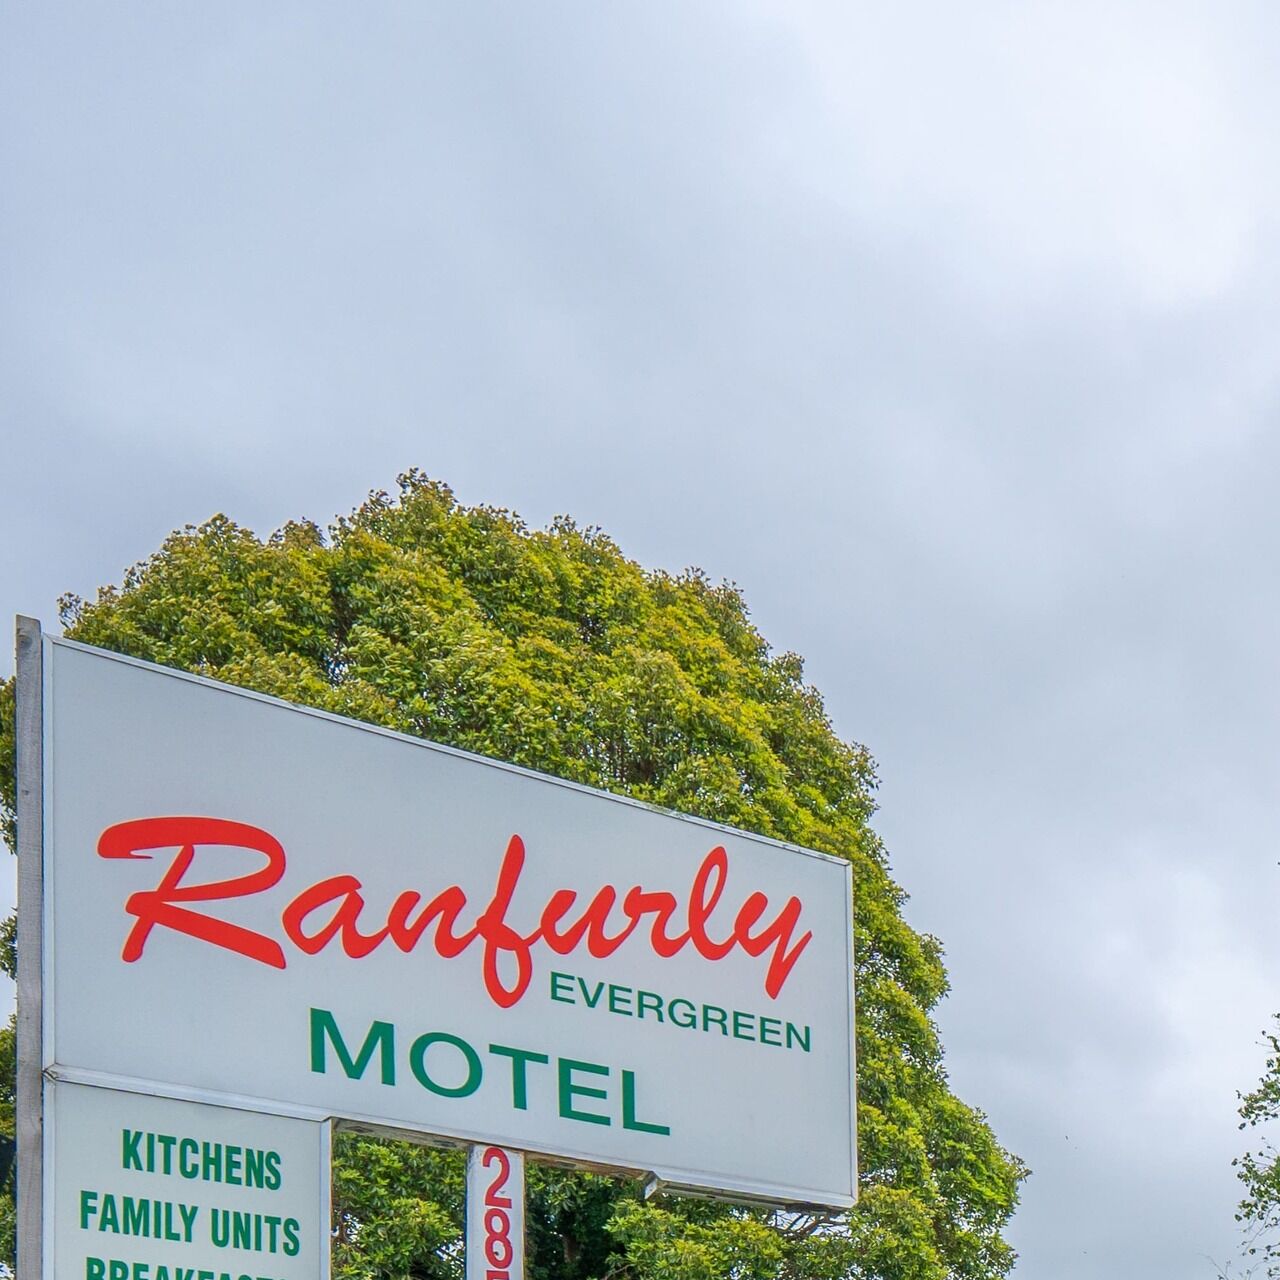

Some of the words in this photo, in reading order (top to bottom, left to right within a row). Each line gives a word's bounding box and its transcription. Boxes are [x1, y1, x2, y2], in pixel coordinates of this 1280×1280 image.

[97, 816, 812, 1009] Ranfurly
[550, 971, 811, 1053] EVERGREEN
[310, 1007, 671, 1137] MOTEL
[122, 1128, 282, 1191] KITCHENS
[80, 1190, 199, 1243] FAMILY
[211, 1208, 301, 1257] UNITS
